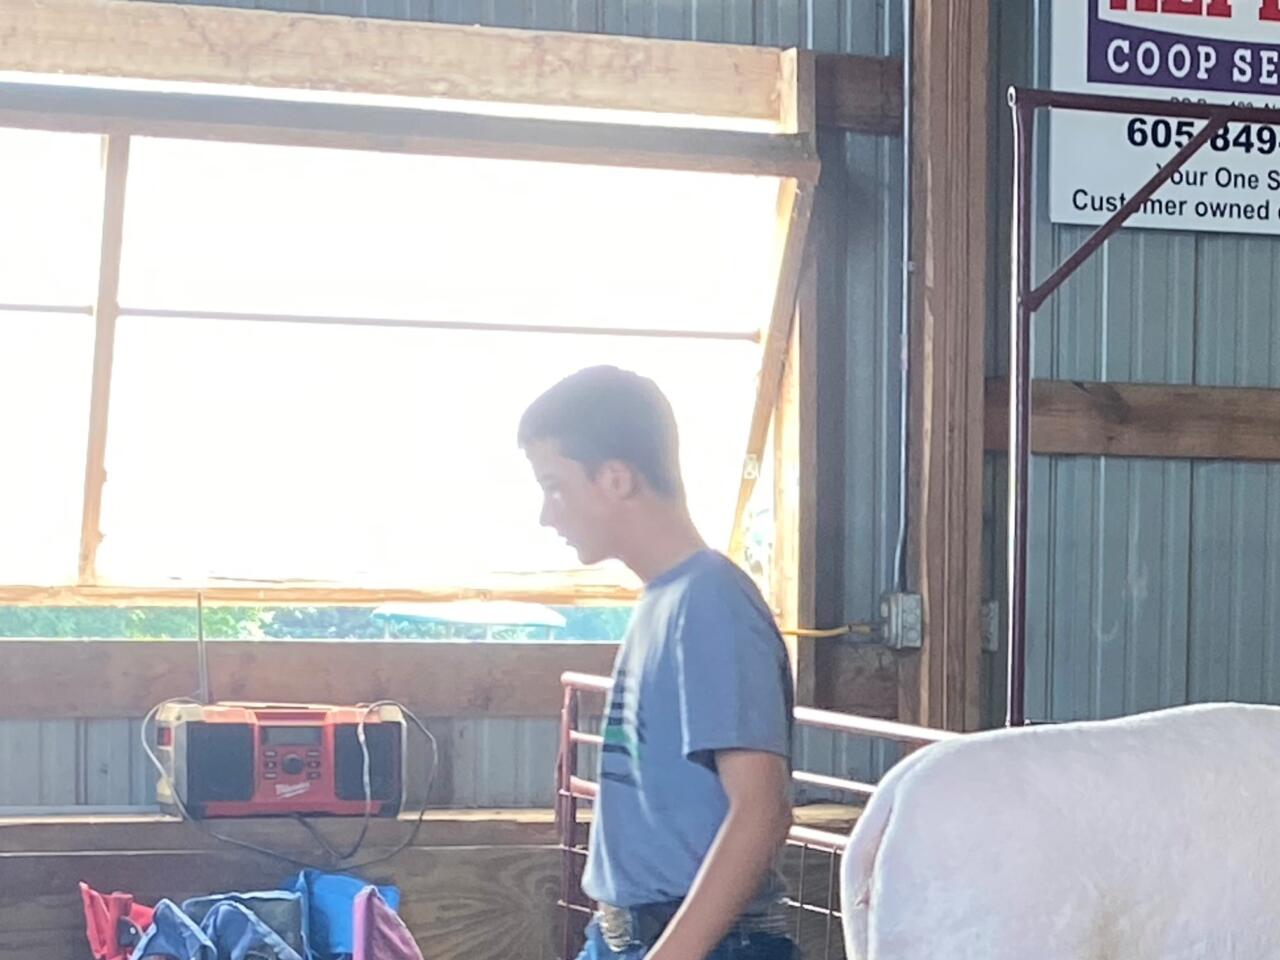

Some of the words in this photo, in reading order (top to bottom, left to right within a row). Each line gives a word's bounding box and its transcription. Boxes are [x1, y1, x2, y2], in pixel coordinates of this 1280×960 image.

[1107, 38, 1217, 79] COOP
[1156, 163, 1208, 186] our
[1215, 167, 1259, 190] One
[1072, 189, 1187, 217] Custmer
[1195, 200, 1270, 220] owned
